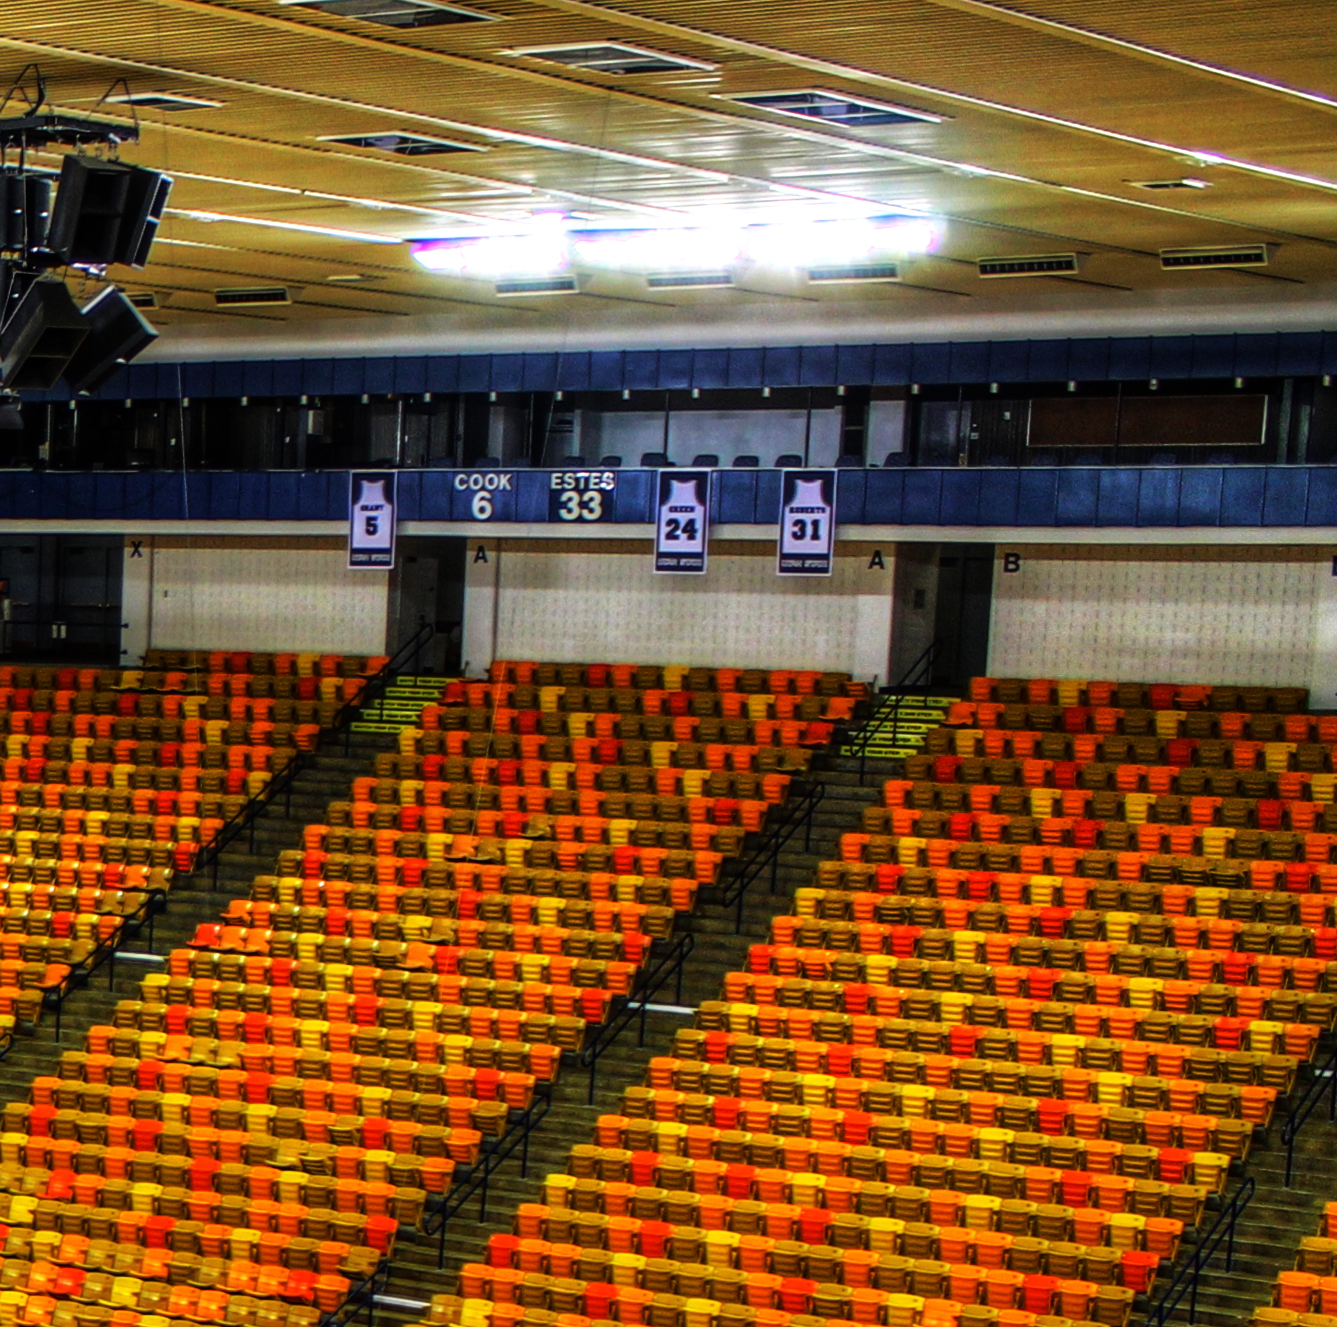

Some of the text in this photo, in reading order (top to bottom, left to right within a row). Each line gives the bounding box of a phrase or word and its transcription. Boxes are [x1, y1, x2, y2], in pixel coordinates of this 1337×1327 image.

[454, 473, 513, 491] COOK
[550, 471, 616, 490] ESTES
[471, 490, 493, 520] 6
[558, 490, 603, 521] 33
[365, 515, 379, 536] 5
[664, 517, 699, 541] 24
[791, 518, 823, 541] 31
[130, 540, 143, 559] X
[473, 545, 489, 564] A
[868, 550, 885, 570] A
[1003, 552, 1021, 573] B
